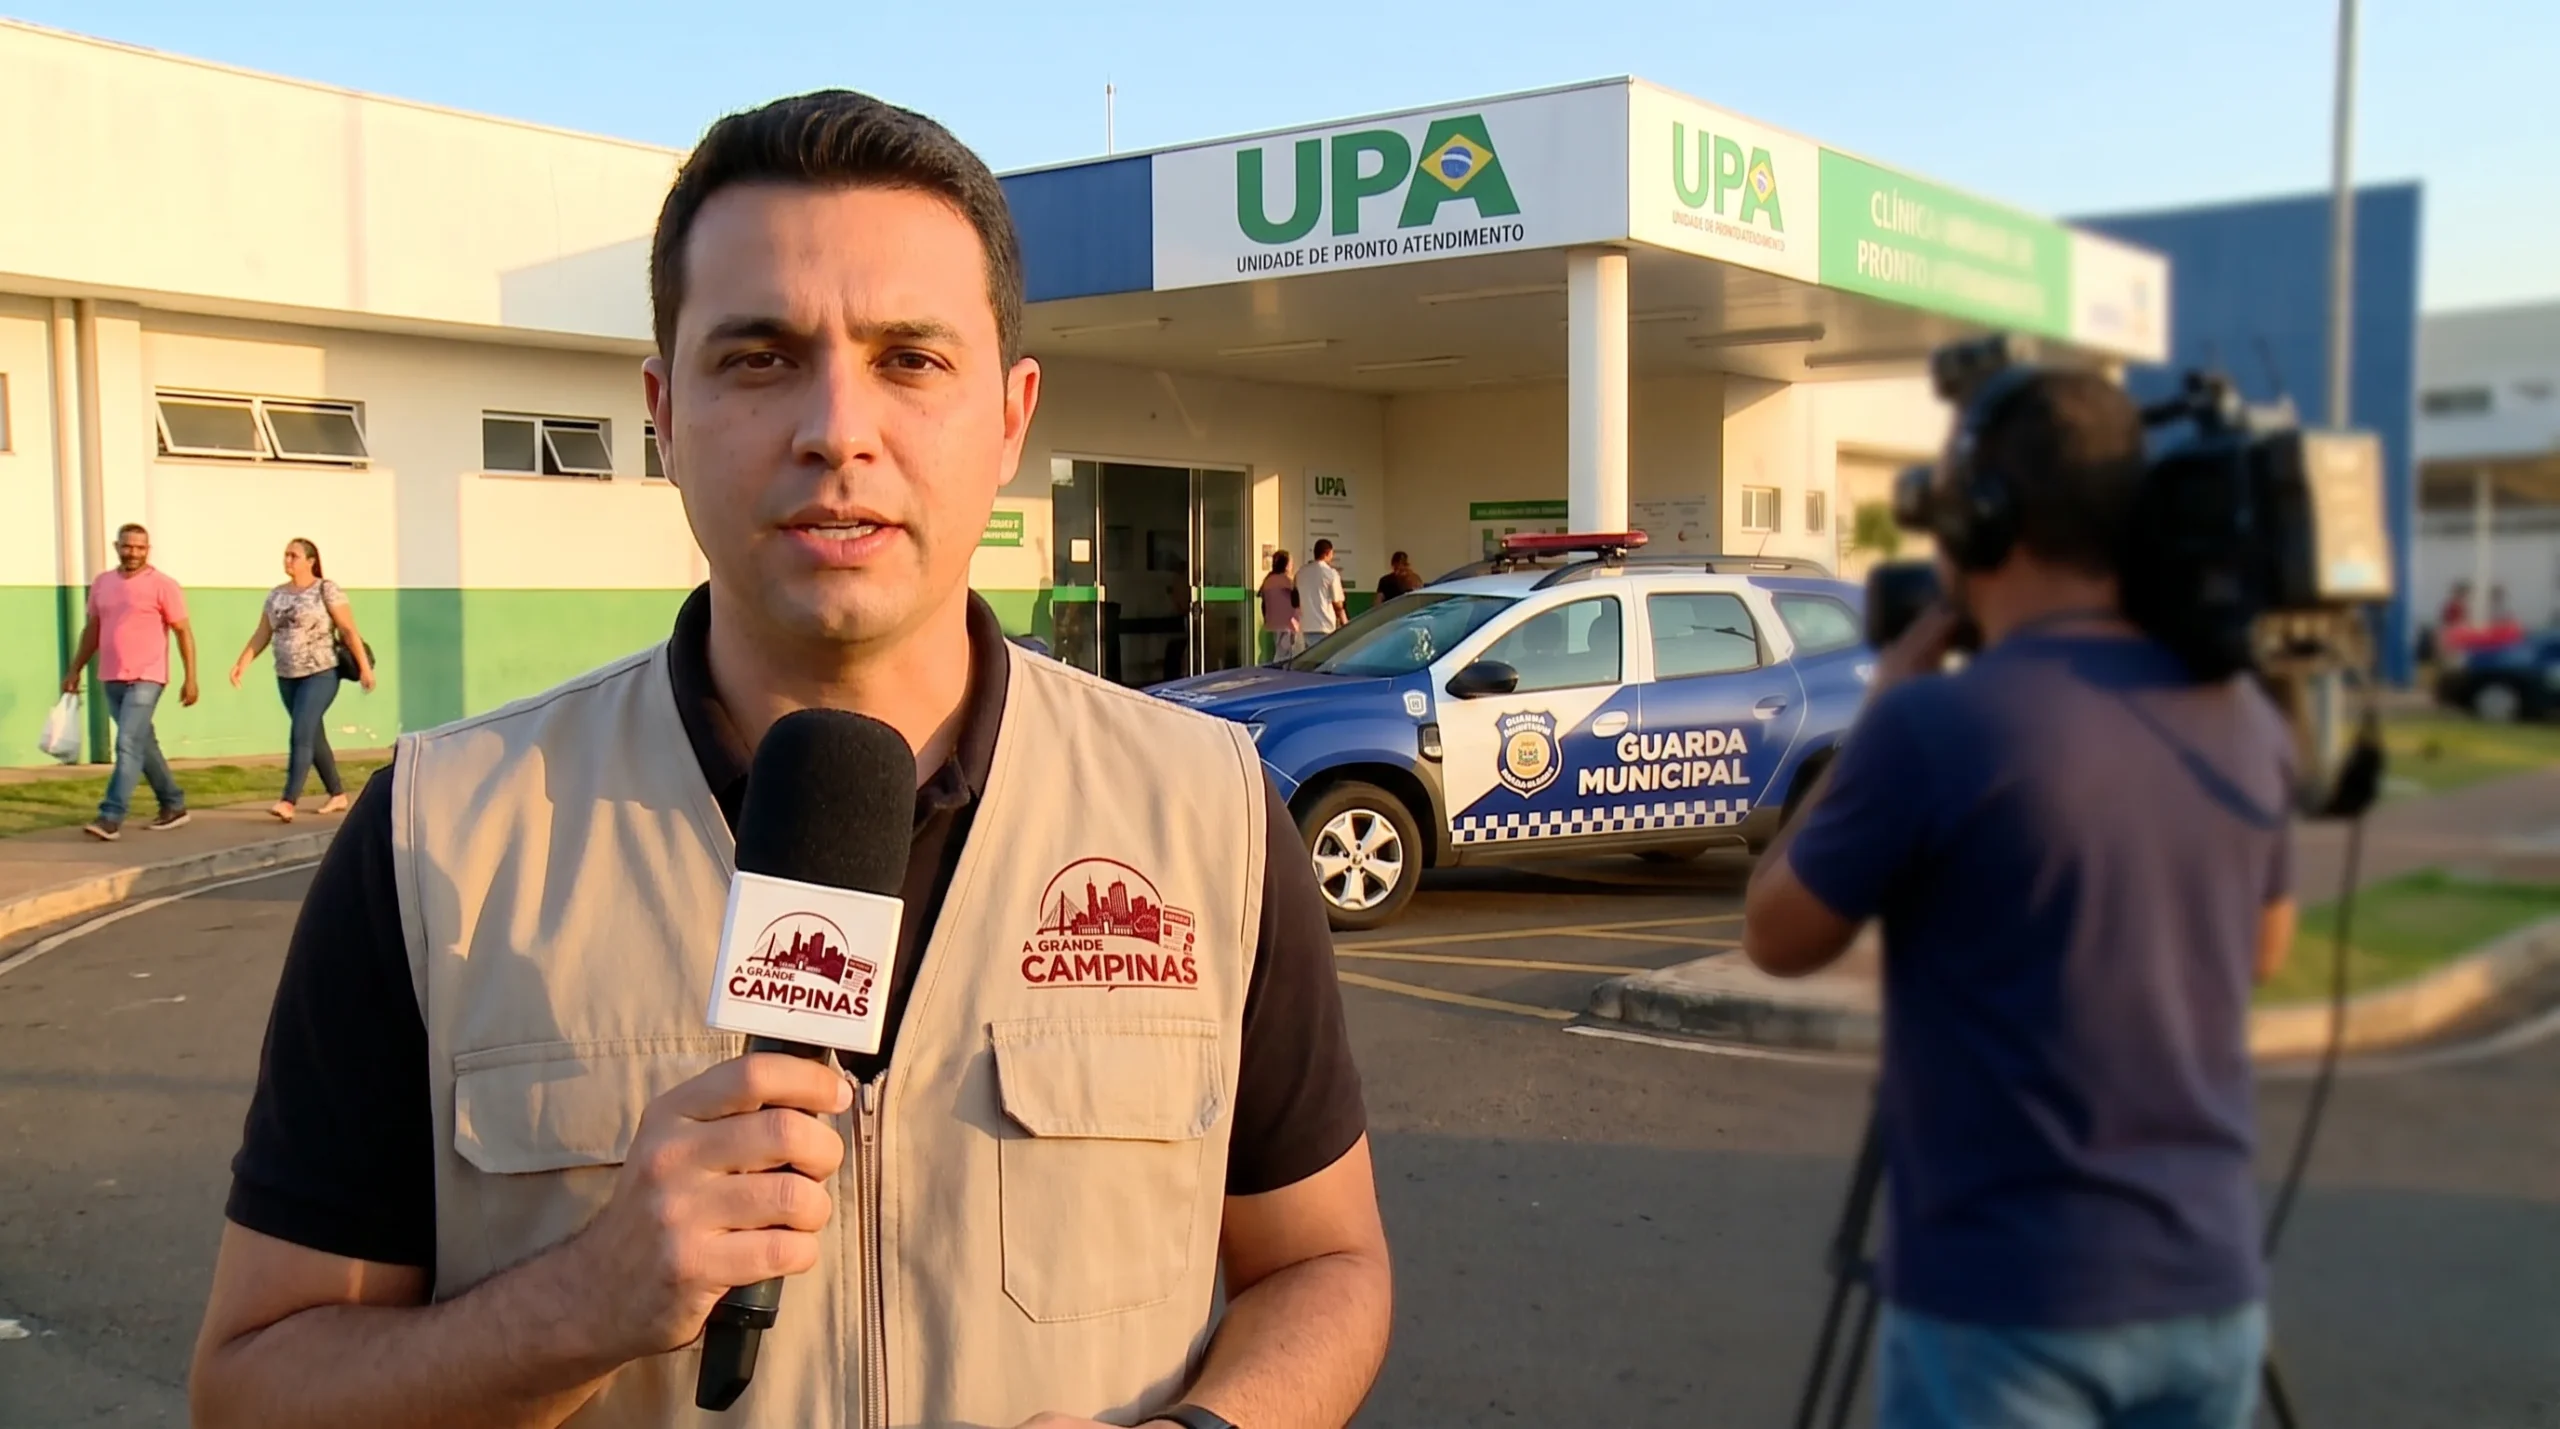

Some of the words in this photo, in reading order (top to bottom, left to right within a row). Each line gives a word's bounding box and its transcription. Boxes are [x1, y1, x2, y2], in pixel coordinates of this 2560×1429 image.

[1236, 113, 1521, 245] UPA
[1673, 121, 1784, 233] UPA
[1237, 250, 1304, 273] UNIDADE
[1309, 246, 1329, 265] DE
[1334, 238, 1398, 261] PRONTO
[1403, 223, 1524, 254] ATENDIMENTO
[1857, 239, 1928, 289] PRONTO
[1315, 476, 1347, 497] UPA
[1617, 728, 1748, 762] GUARDA
[1578, 759, 1750, 796] MUNICIPAL
[1022, 941, 1033, 952] A
[1038, 939, 1104, 951] GRANDE
[734, 966, 743, 974] A
[747, 966, 796, 982] GRANDE
[1021, 954, 1198, 984] CAMPINAS
[728, 977, 869, 1017] CAMPINAS
